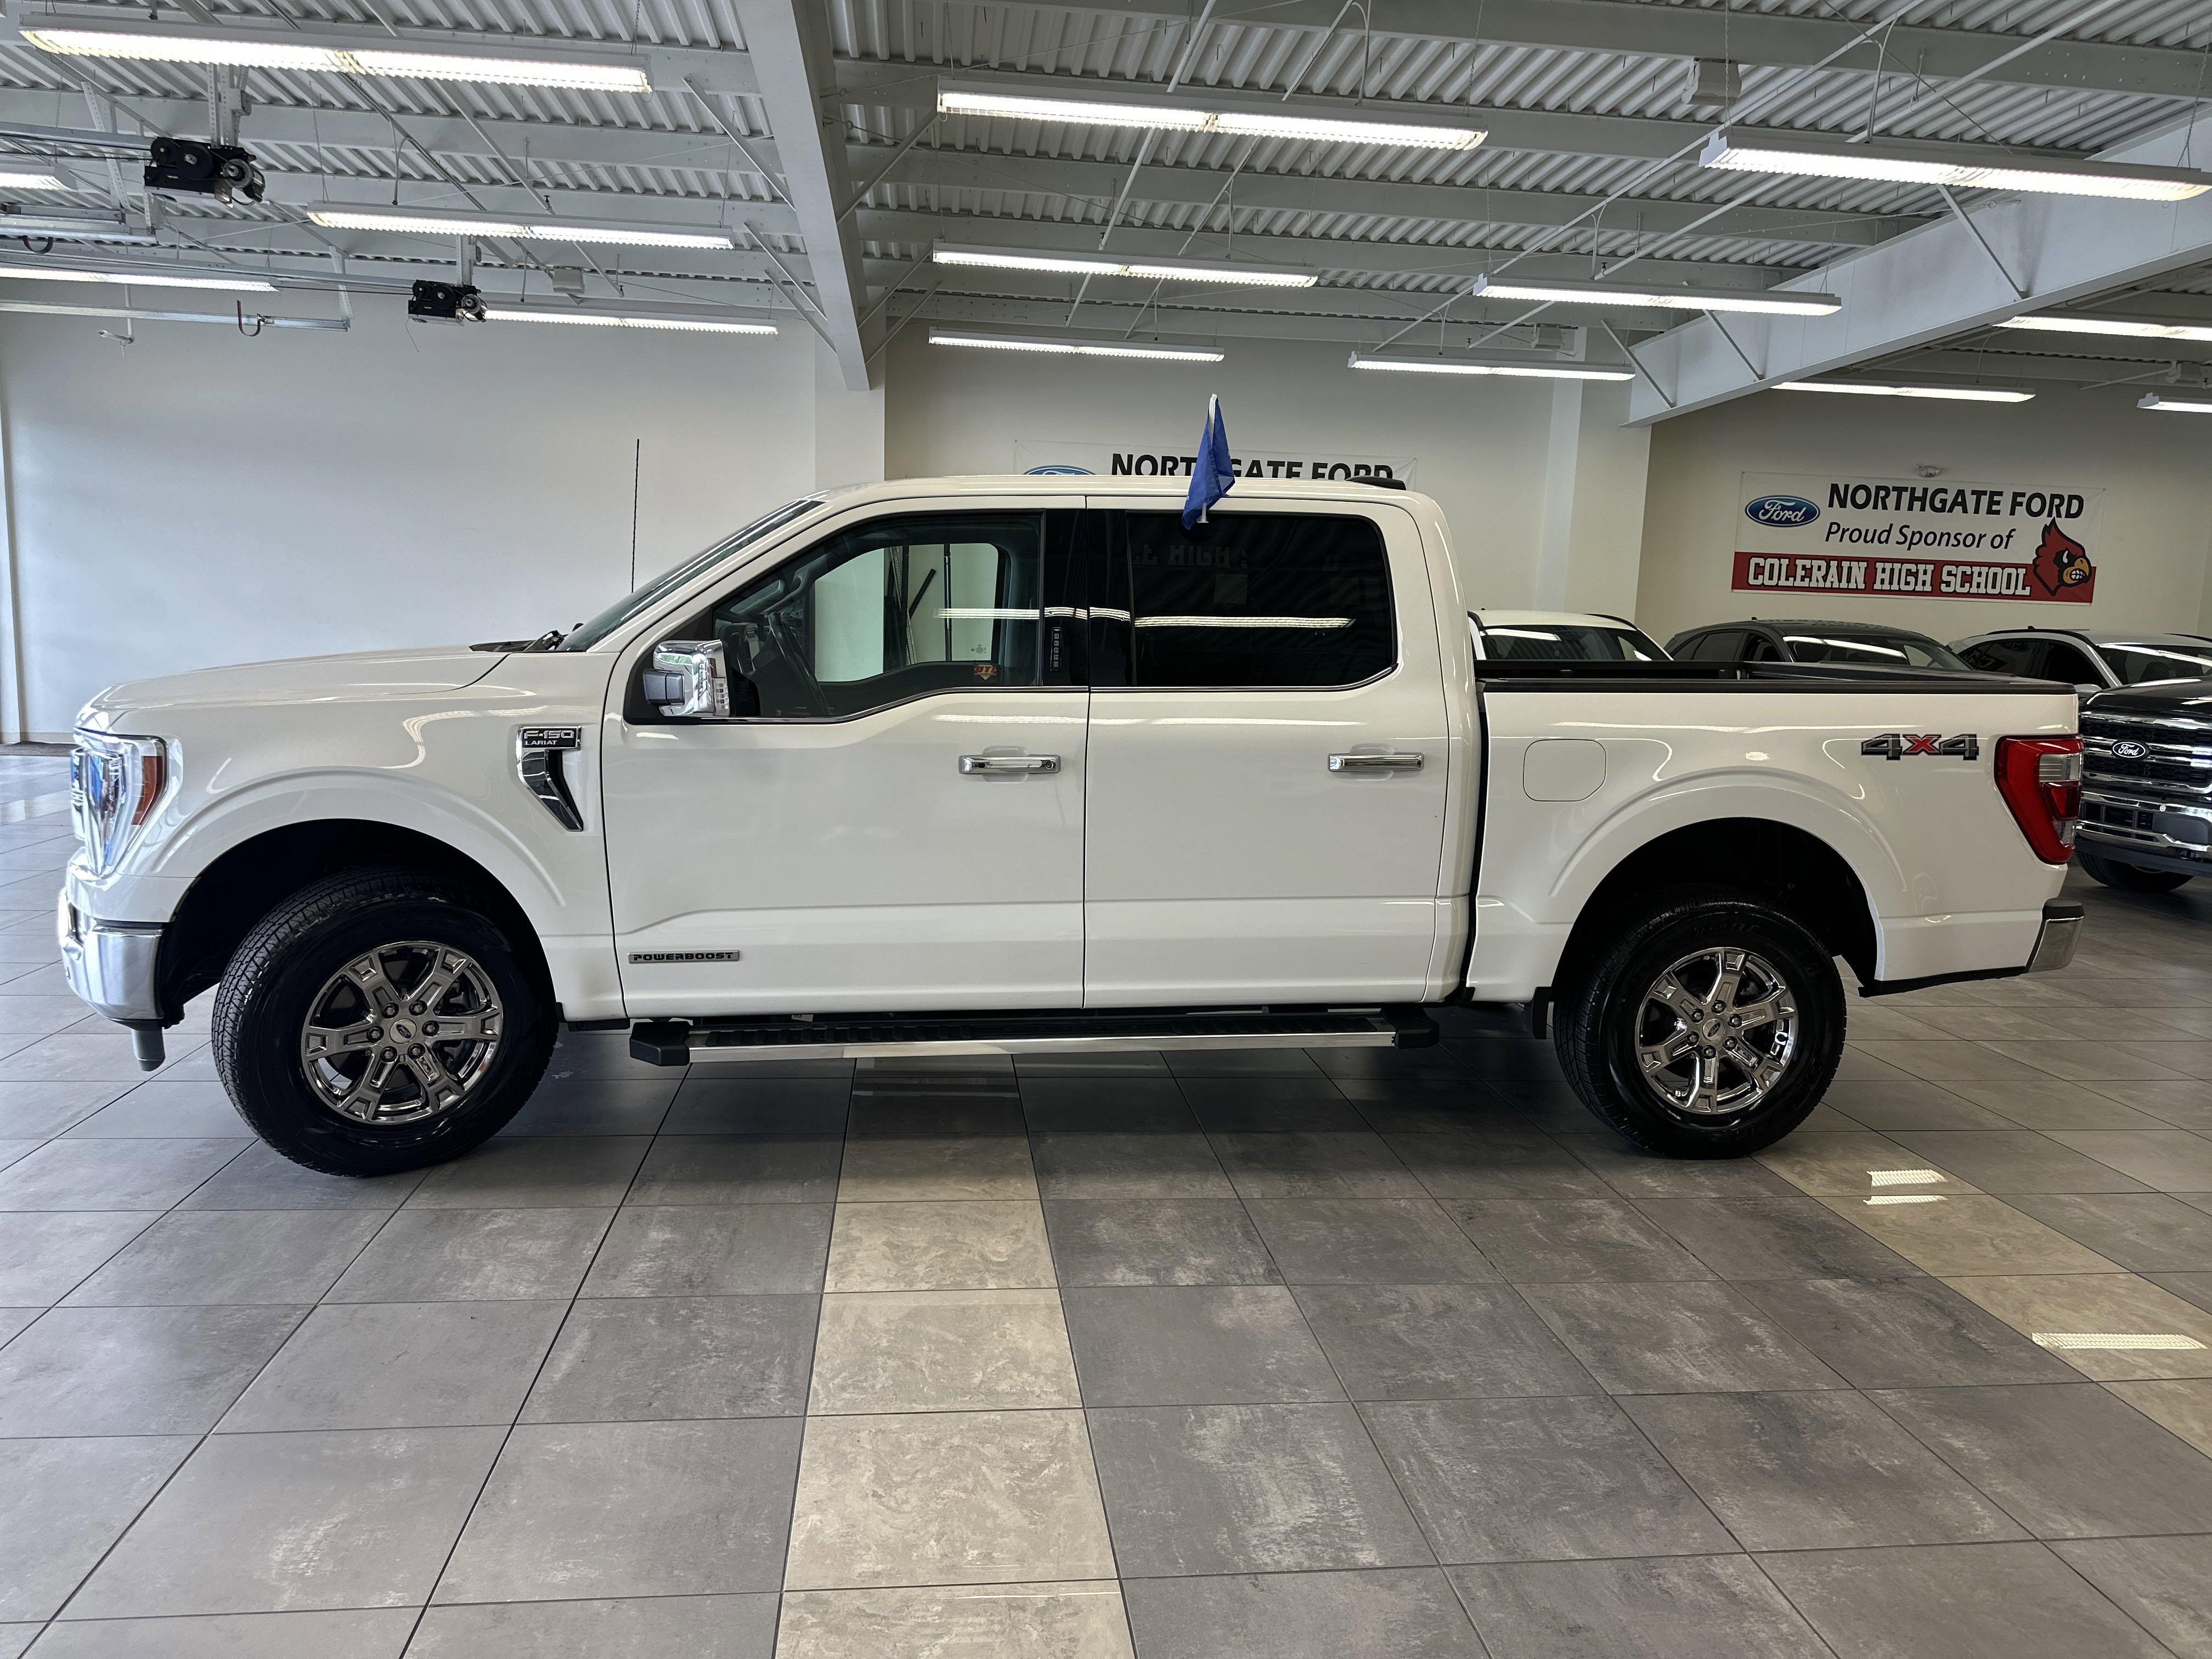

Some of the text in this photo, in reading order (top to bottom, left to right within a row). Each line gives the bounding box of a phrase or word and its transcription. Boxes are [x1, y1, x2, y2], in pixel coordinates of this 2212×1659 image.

[1112, 453, 1303, 479] NORTGATE
[1758, 499, 1807, 522] Ford
[1828, 483, 2084, 519] NORTHGATE FORD
[1825, 522, 2016, 551] Proud Sponsor of
[1748, 557, 2031, 596] COLERAIN HIGH SCHOOL
[524, 730, 574, 739] F-150
[2118, 743, 2140, 755] Ford
[634, 952, 733, 961] POWERBOOST
